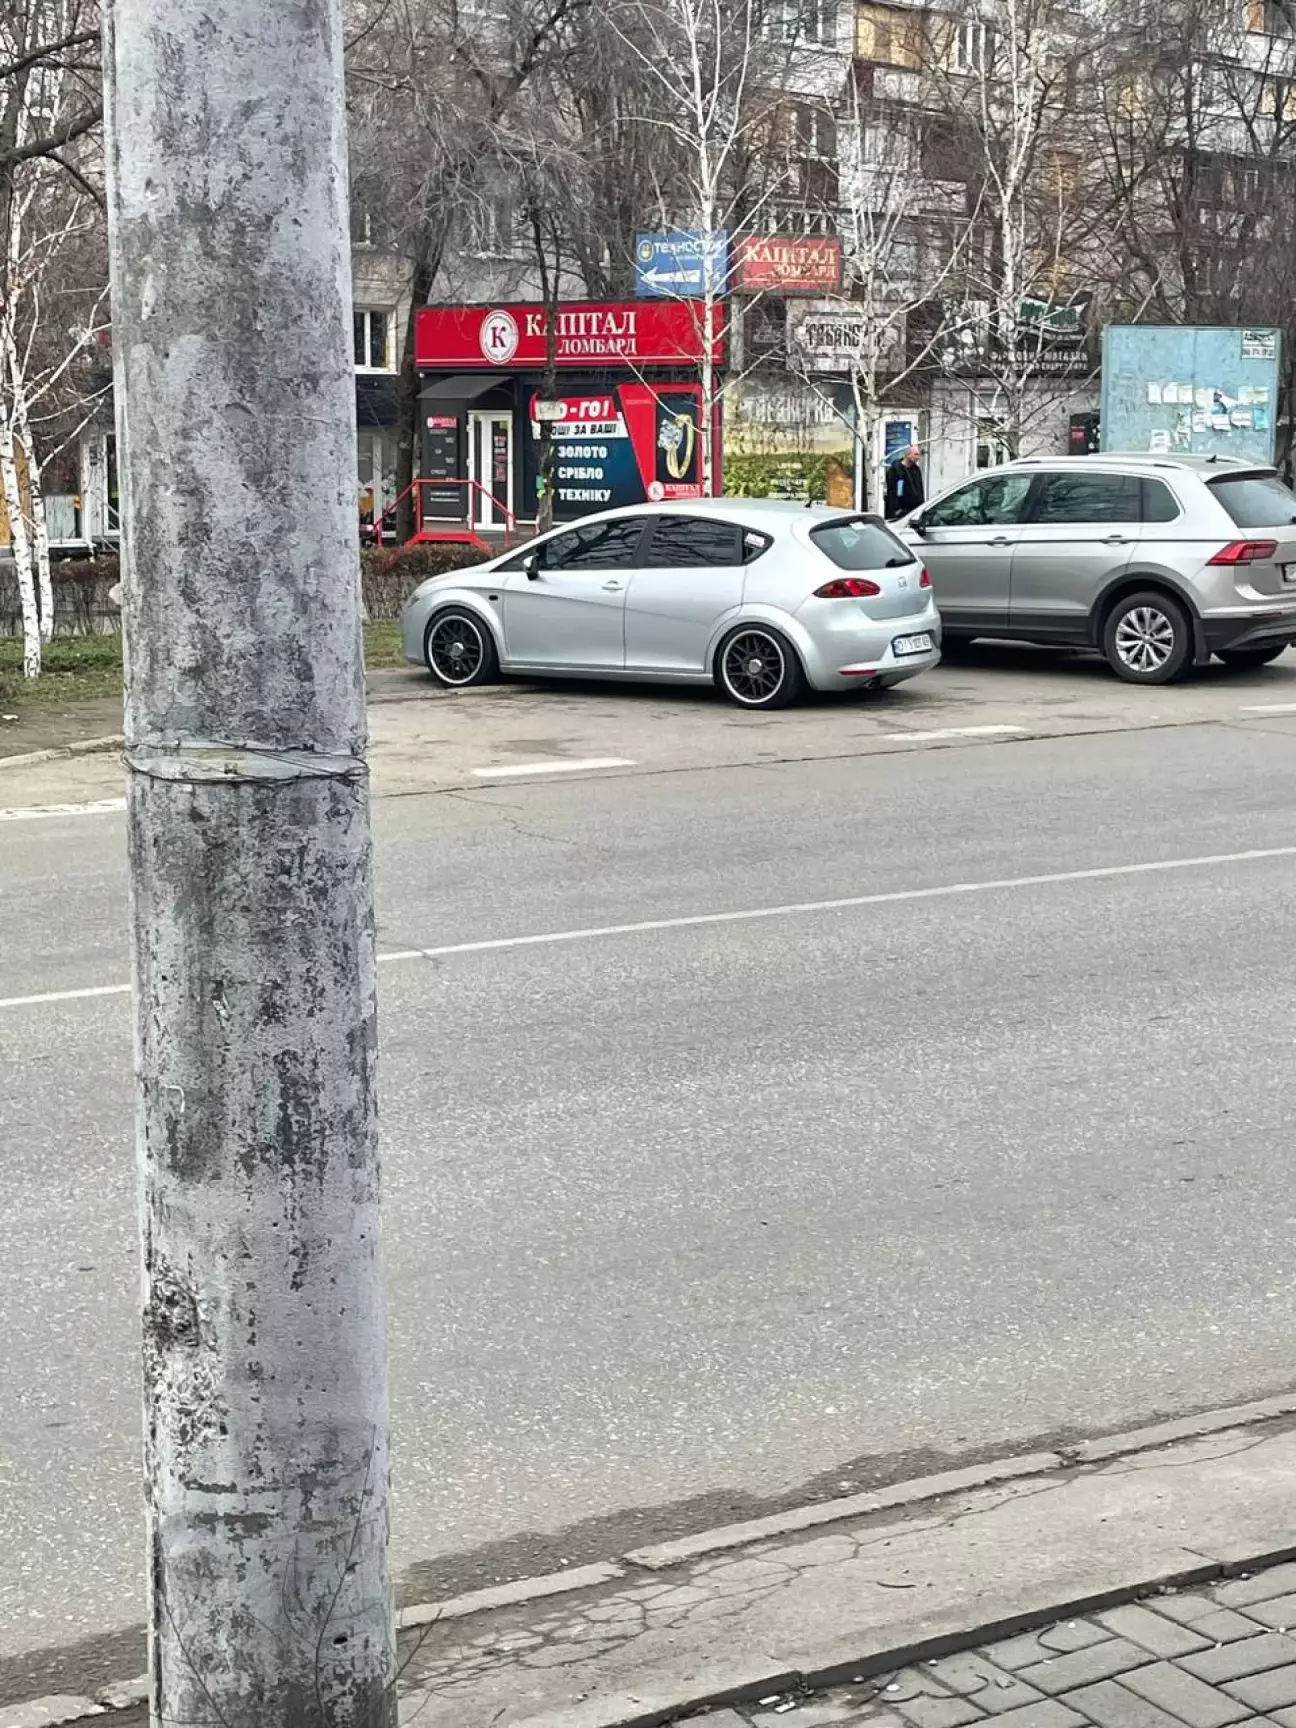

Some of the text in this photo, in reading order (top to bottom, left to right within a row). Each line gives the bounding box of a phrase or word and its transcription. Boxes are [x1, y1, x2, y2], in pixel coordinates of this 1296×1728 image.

[558, 338, 637, 355] ЛОМБАРД
[574, 425, 586, 435] ЗА
[590, 424, 617, 434] ВАШІ
[558, 446, 608, 458] ЗОЛОТО
[558, 467, 604, 479] СРІБЛО
[558, 488, 611, 502] ТЕХНІКУ
